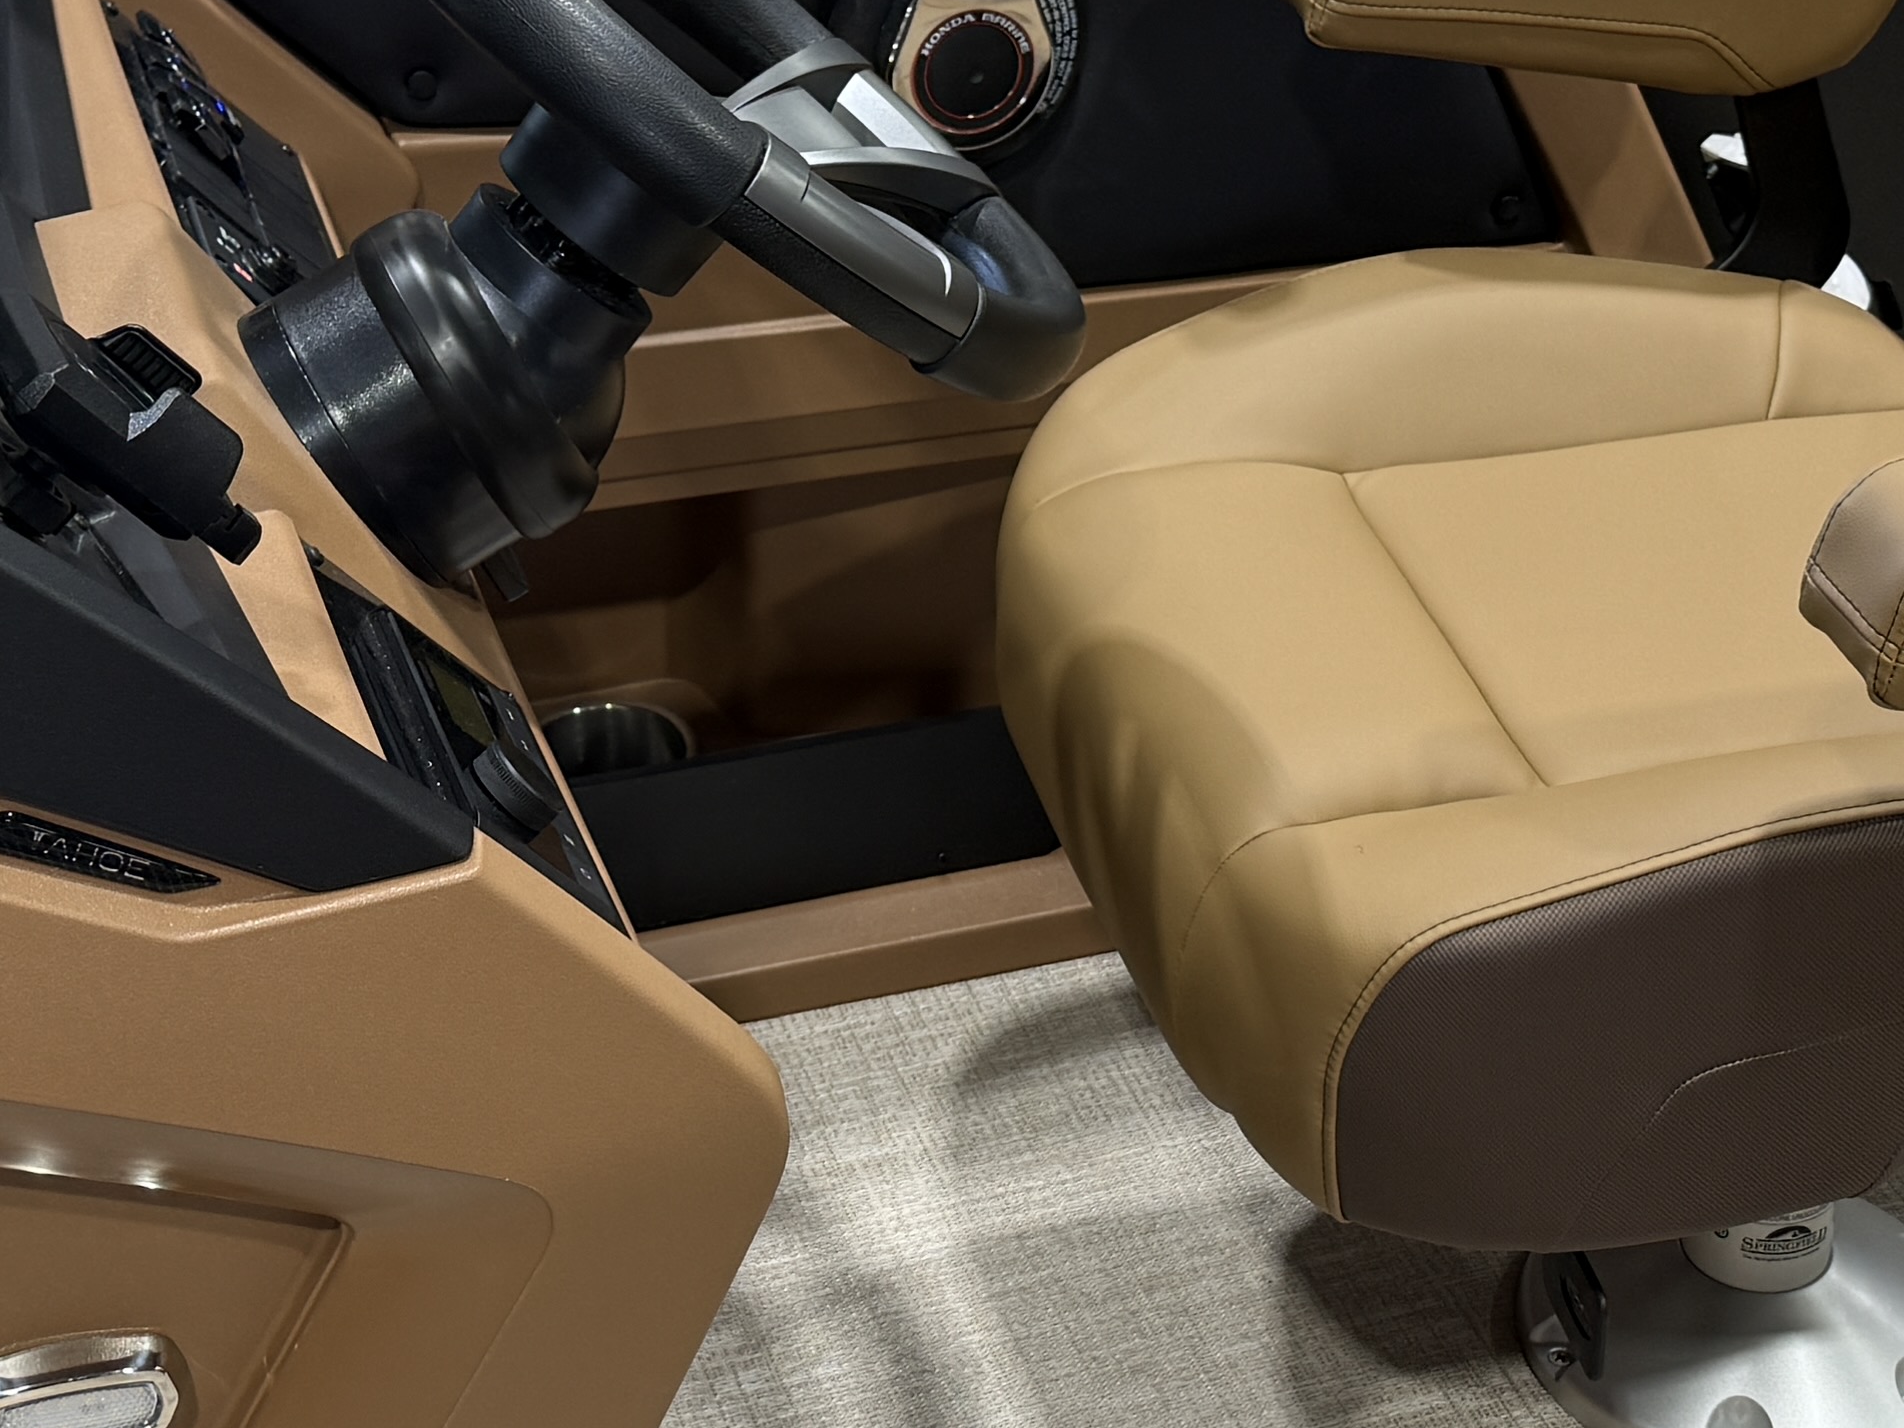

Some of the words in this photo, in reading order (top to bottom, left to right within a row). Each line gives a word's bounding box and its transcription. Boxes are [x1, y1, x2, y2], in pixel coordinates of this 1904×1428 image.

[921, 14, 976, 56] HONDA
[981, 13, 1031, 54] MARINE
[31, 829, 151, 881] TAHOE
[1741, 1226, 1828, 1252] SPRINGFIELD
